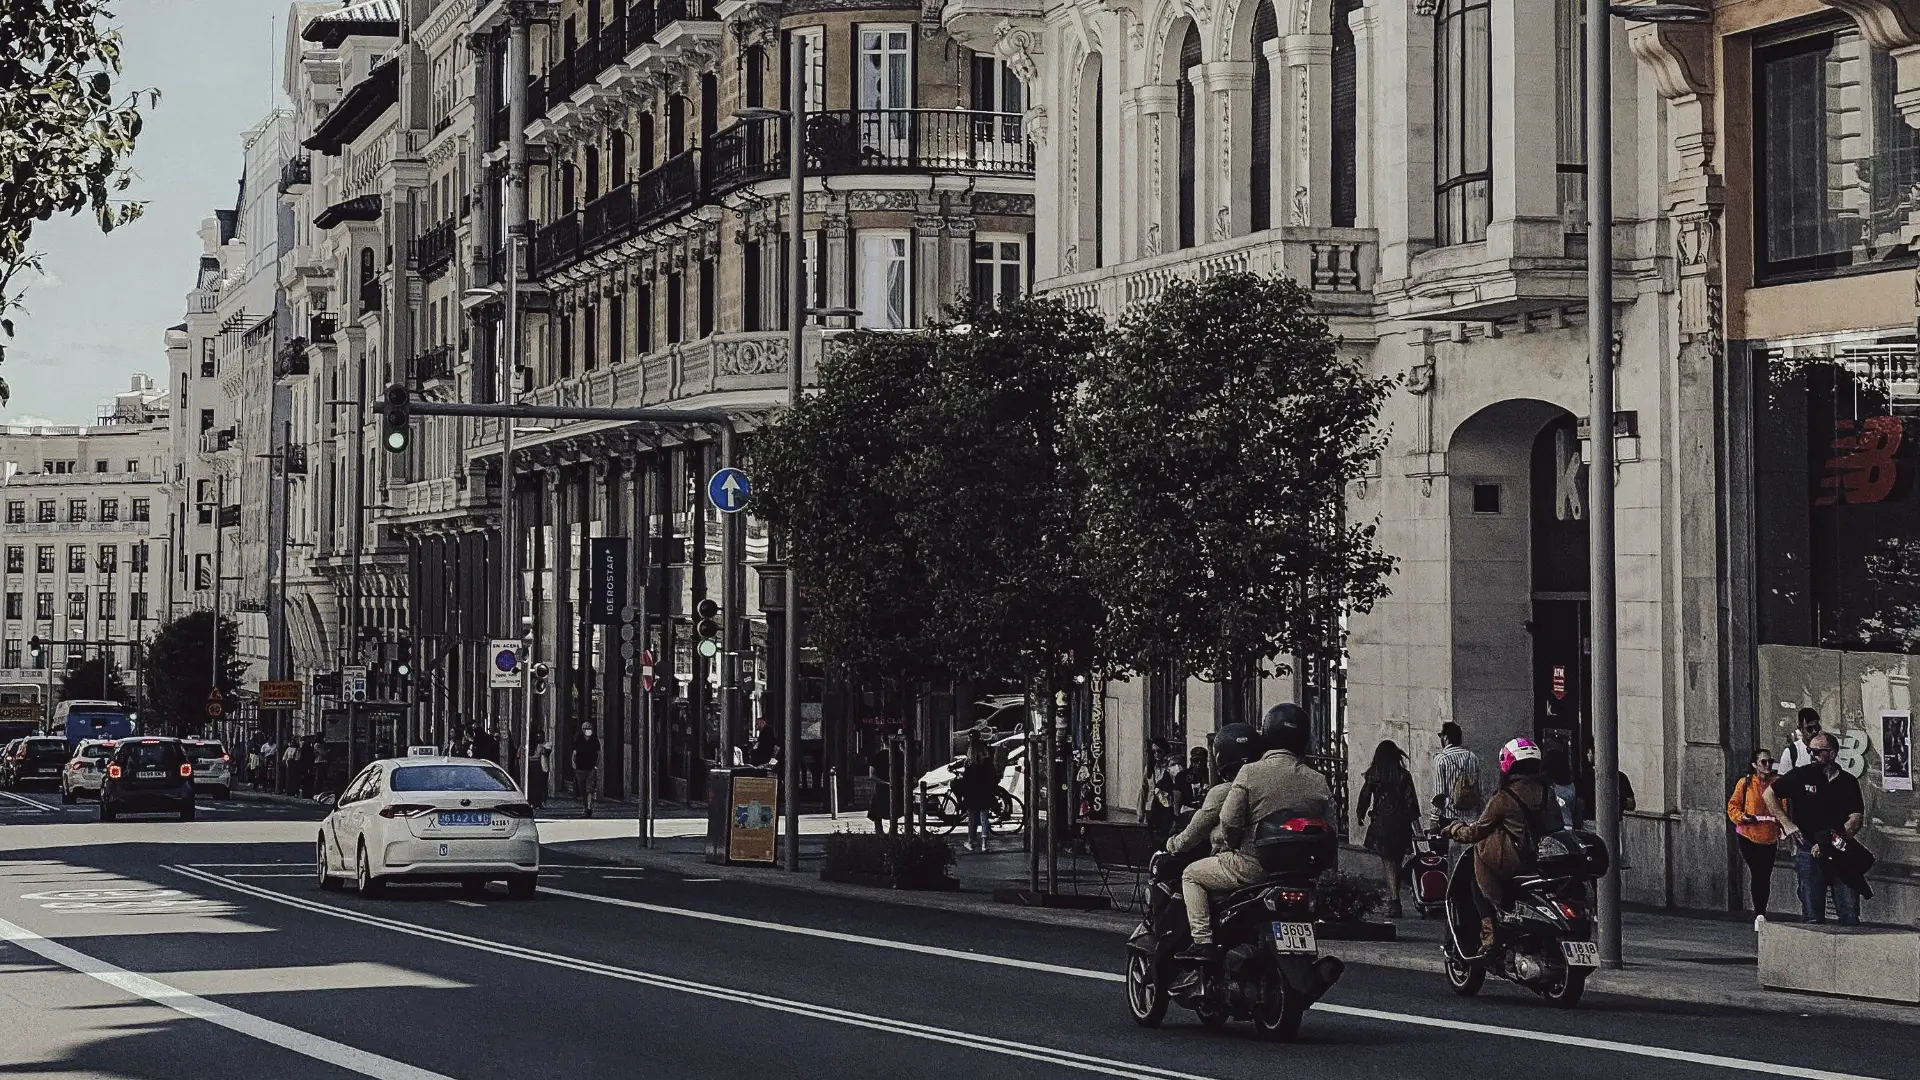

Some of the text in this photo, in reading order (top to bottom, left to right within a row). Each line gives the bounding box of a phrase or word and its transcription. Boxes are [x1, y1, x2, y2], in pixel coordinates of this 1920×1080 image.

[606, 555, 614, 616] IBEROSTAR
[428, 817, 436, 828] X
[1281, 923, 1312, 937] 3605
[1285, 936, 1307, 949] JLW
[1572, 943, 1596, 954] 1818
